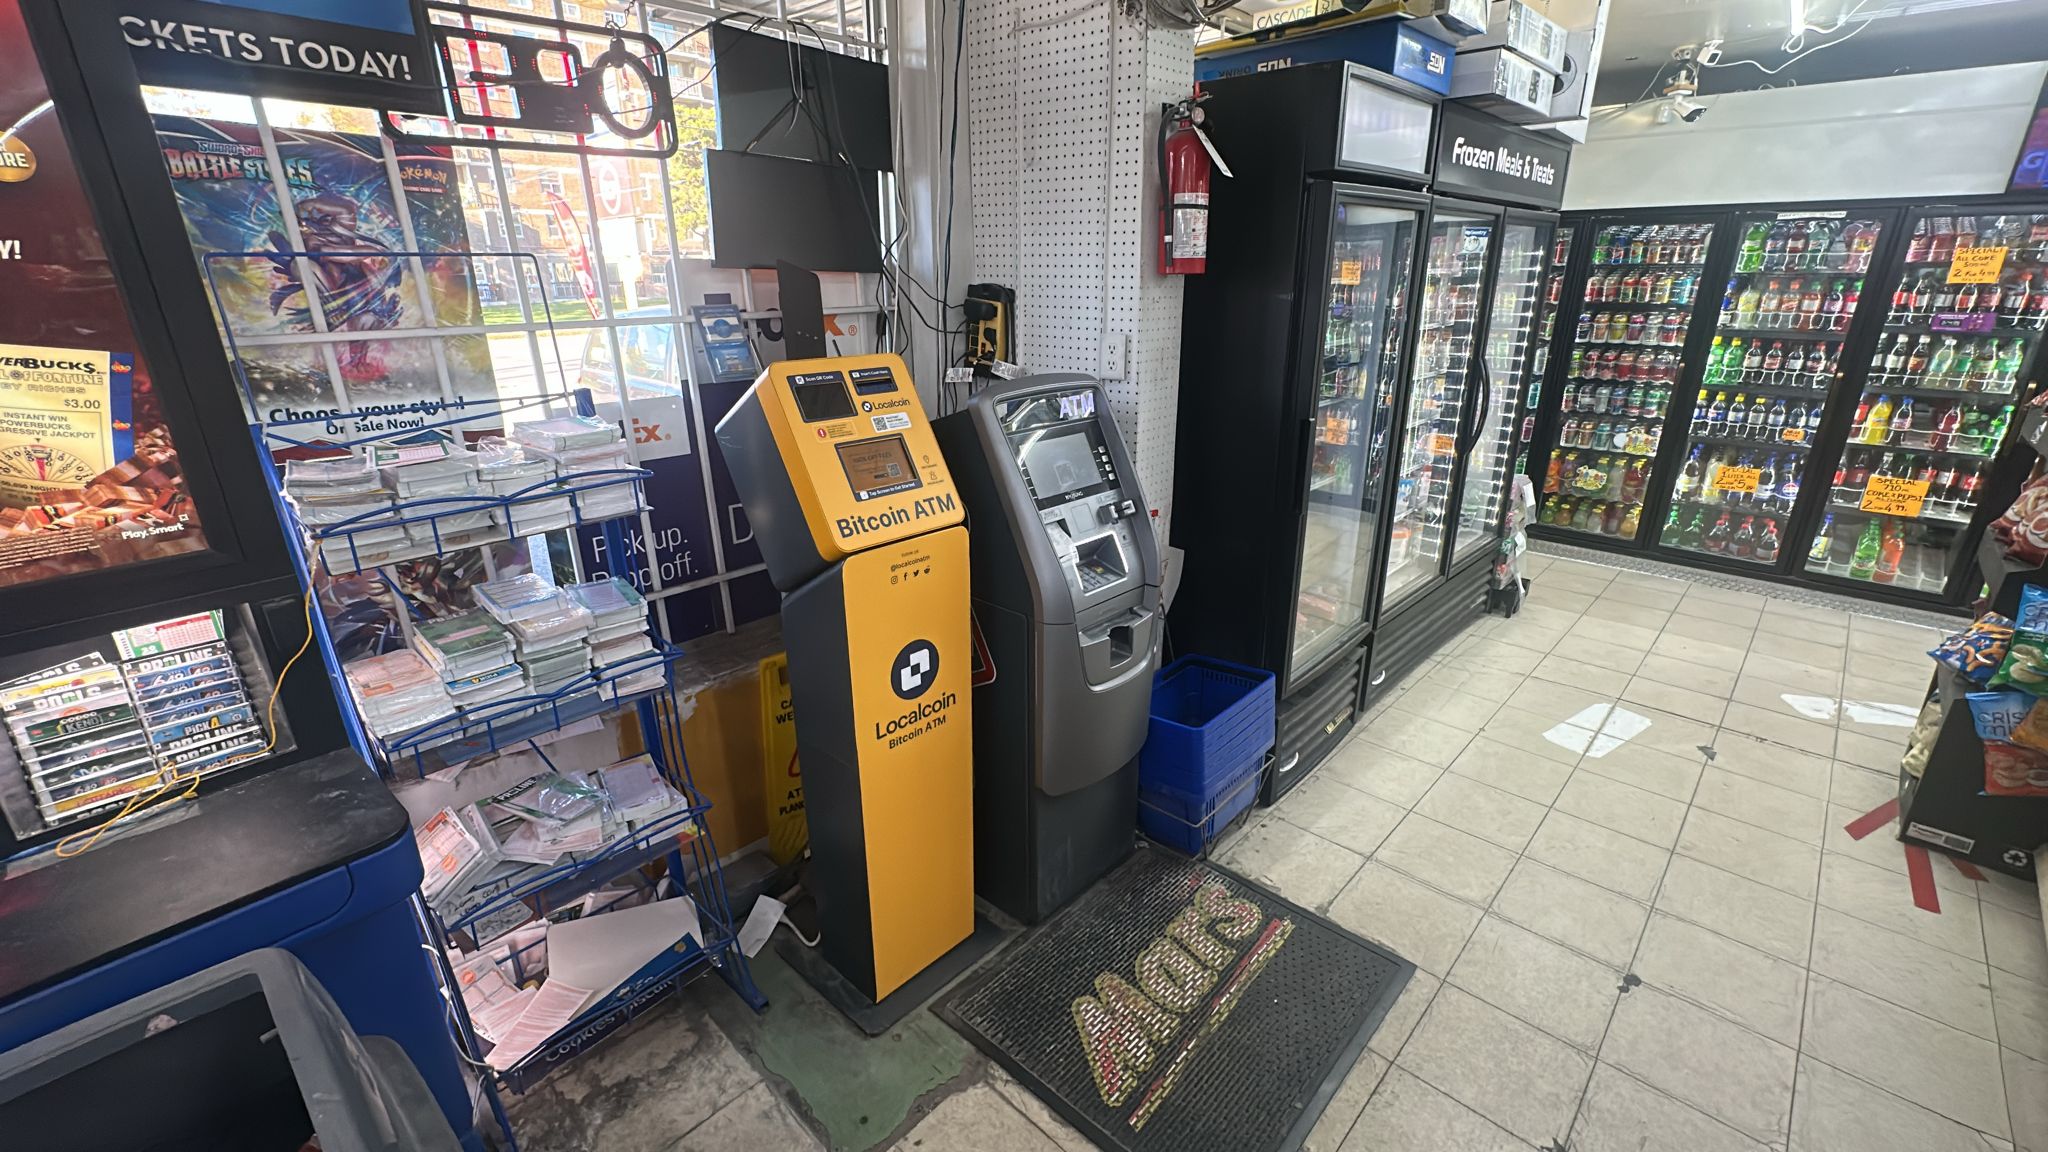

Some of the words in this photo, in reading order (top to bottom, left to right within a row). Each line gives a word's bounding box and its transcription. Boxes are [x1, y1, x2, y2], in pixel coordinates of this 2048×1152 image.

[270, 36, 413, 81] TODAY!
[165, 148, 245, 180] BATTLE
[1452, 136, 1495, 171] Frozen
[1496, 147, 1524, 178] Meals
[1523, 155, 1532, 179] &
[1531, 157, 1555, 186] Treats
[3, 412, 47, 421] INSTANT
[48, 414, 68, 423] WIN
[64, 398, 102, 410] $3.00
[872, 398, 911, 411] Localcoin
[1059, 391, 1096, 419] ATM
[50, 432, 97, 440] JACKPOT
[387, 416, 425, 430] Now!
[836, 506, 911, 540] Bitcoin
[914, 493, 956, 520] ATM
[652, 526, 689, 553] up.
[661, 551, 699, 581] off.
[875, 691, 957, 741] Localcoin
[889, 726, 924, 750] Bitcoin
[924, 714, 947, 733] ATM
